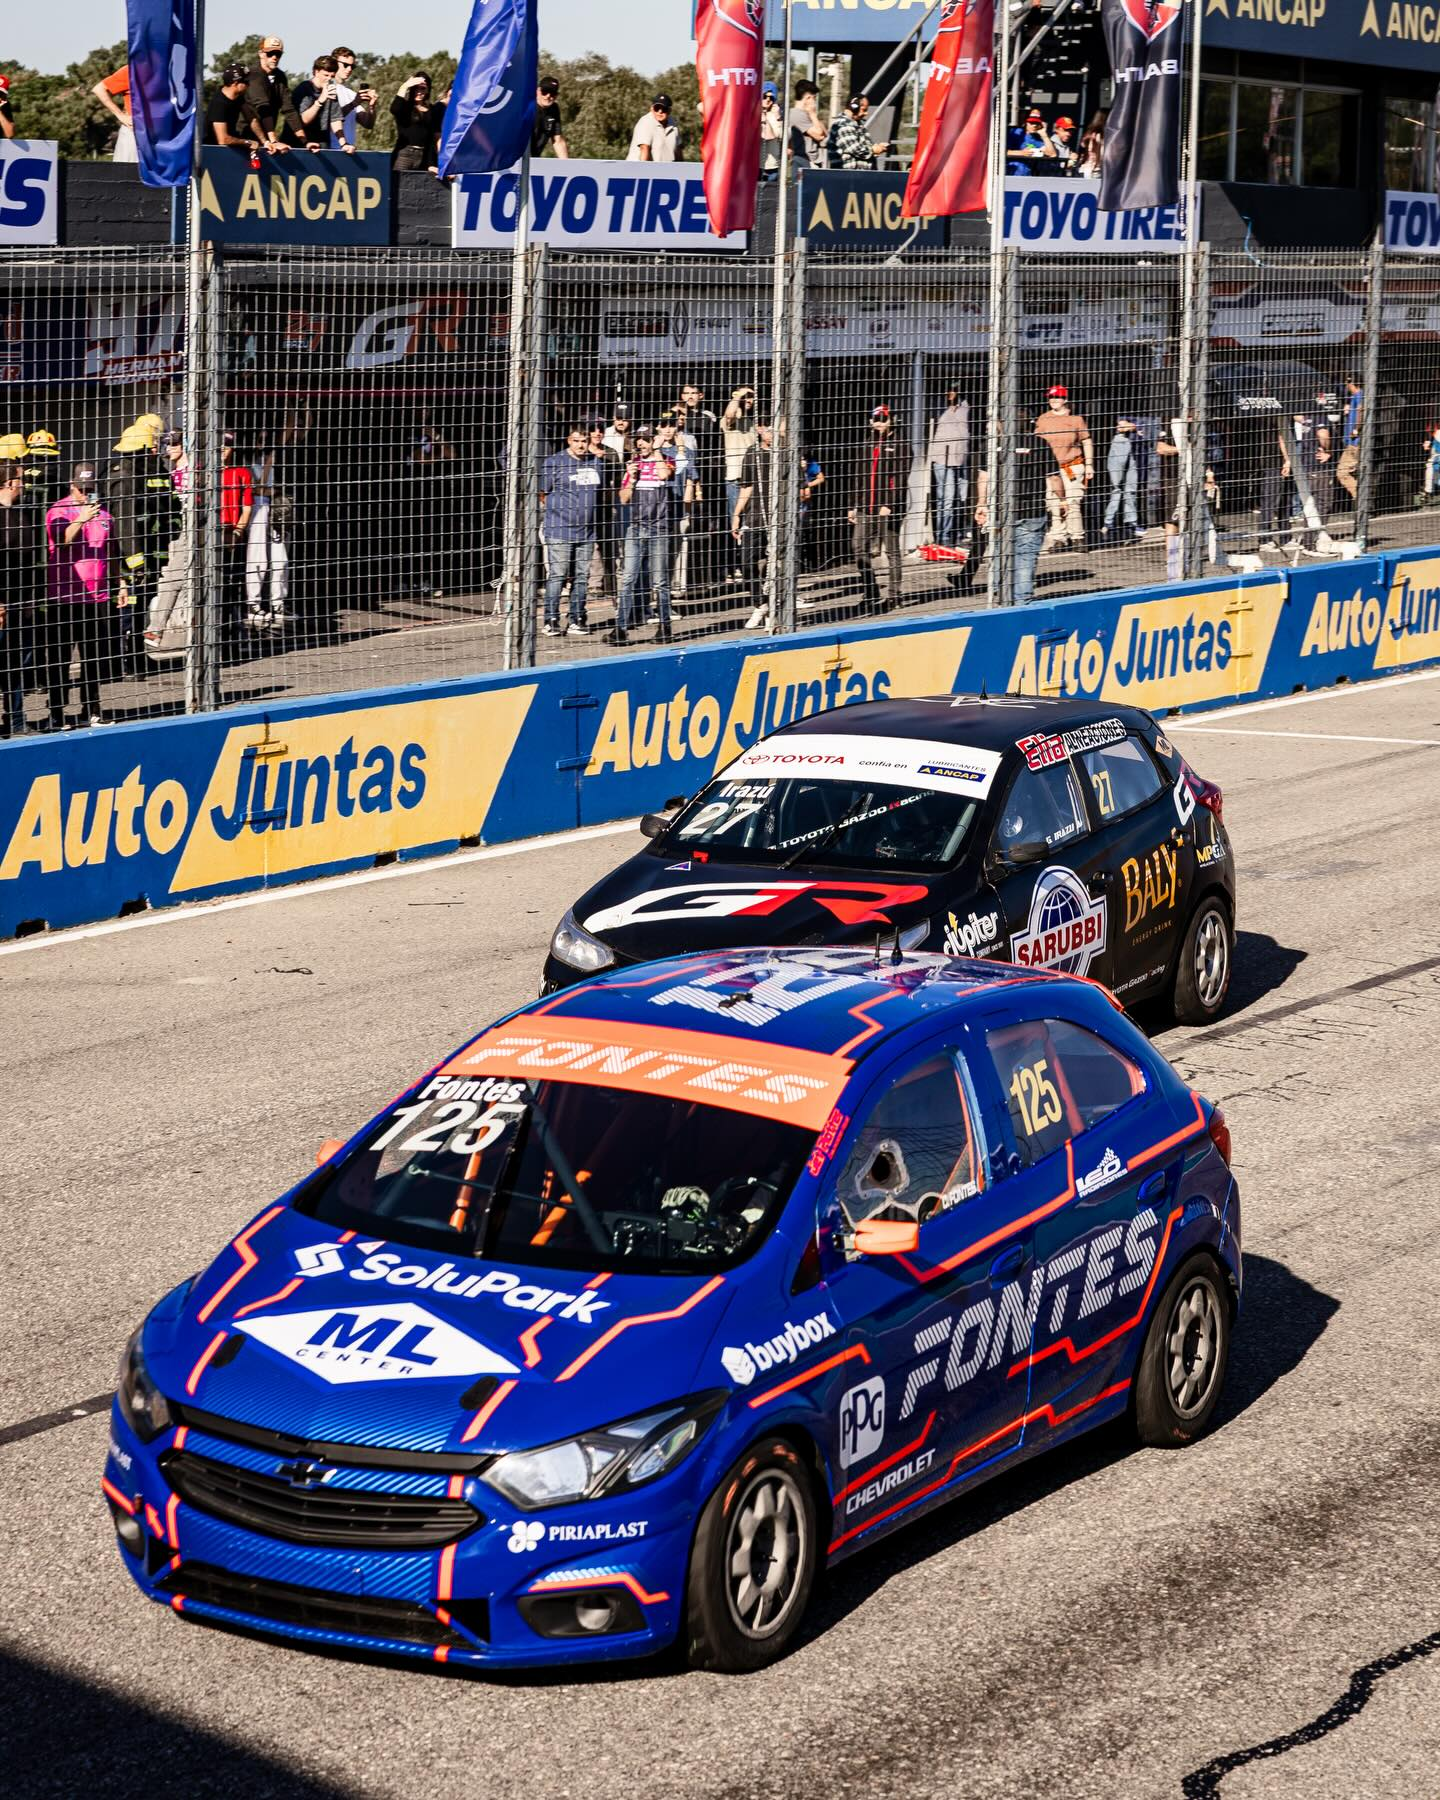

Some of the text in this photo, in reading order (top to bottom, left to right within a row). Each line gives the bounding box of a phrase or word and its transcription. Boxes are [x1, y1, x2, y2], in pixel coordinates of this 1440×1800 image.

[1236, 0, 1326, 28] ANCAP
[236, 173, 382, 221] ANCAP
[460, 173, 711, 234] TOYO TIRE
[1003, 190, 1098, 241] TOYO
[1300, 588, 1381, 657] Auto
[1006, 613, 1231, 698] Auto Juntas
[584, 684, 720, 777] Auto
[772, 755, 845, 765] TOYOTA
[928, 759, 987, 772] LUBRICANTES
[934, 769, 980, 780] ANCAP
[0, 735, 427, 880] Auto Juntas
[719, 782, 776, 798] Irazú
[1093, 770, 1115, 816] 27
[679, 801, 765, 835] 27
[583, 880, 929, 935] GR
[1121, 843, 1178, 933] BALY
[1017, 912, 1102, 967] SARUBBI
[417, 1075, 527, 1103] Fontes
[461, 1036, 831, 1105] FONTES
[1009, 1058, 1063, 1137] 125
[368, 1100, 528, 1155] 125
[349, 1253, 612, 1324] SoluPark
[898, 1207, 1159, 1422] FONTES
[295, 1347, 414, 1375] CENTER
[306, 1312, 439, 1367] ML
[744, 1311, 837, 1372] buybox
[842, 1388, 883, 1456] PPG
[845, 1448, 936, 1515] CHEVROLET
[548, 1520, 649, 1541] PIRIAPLAST
